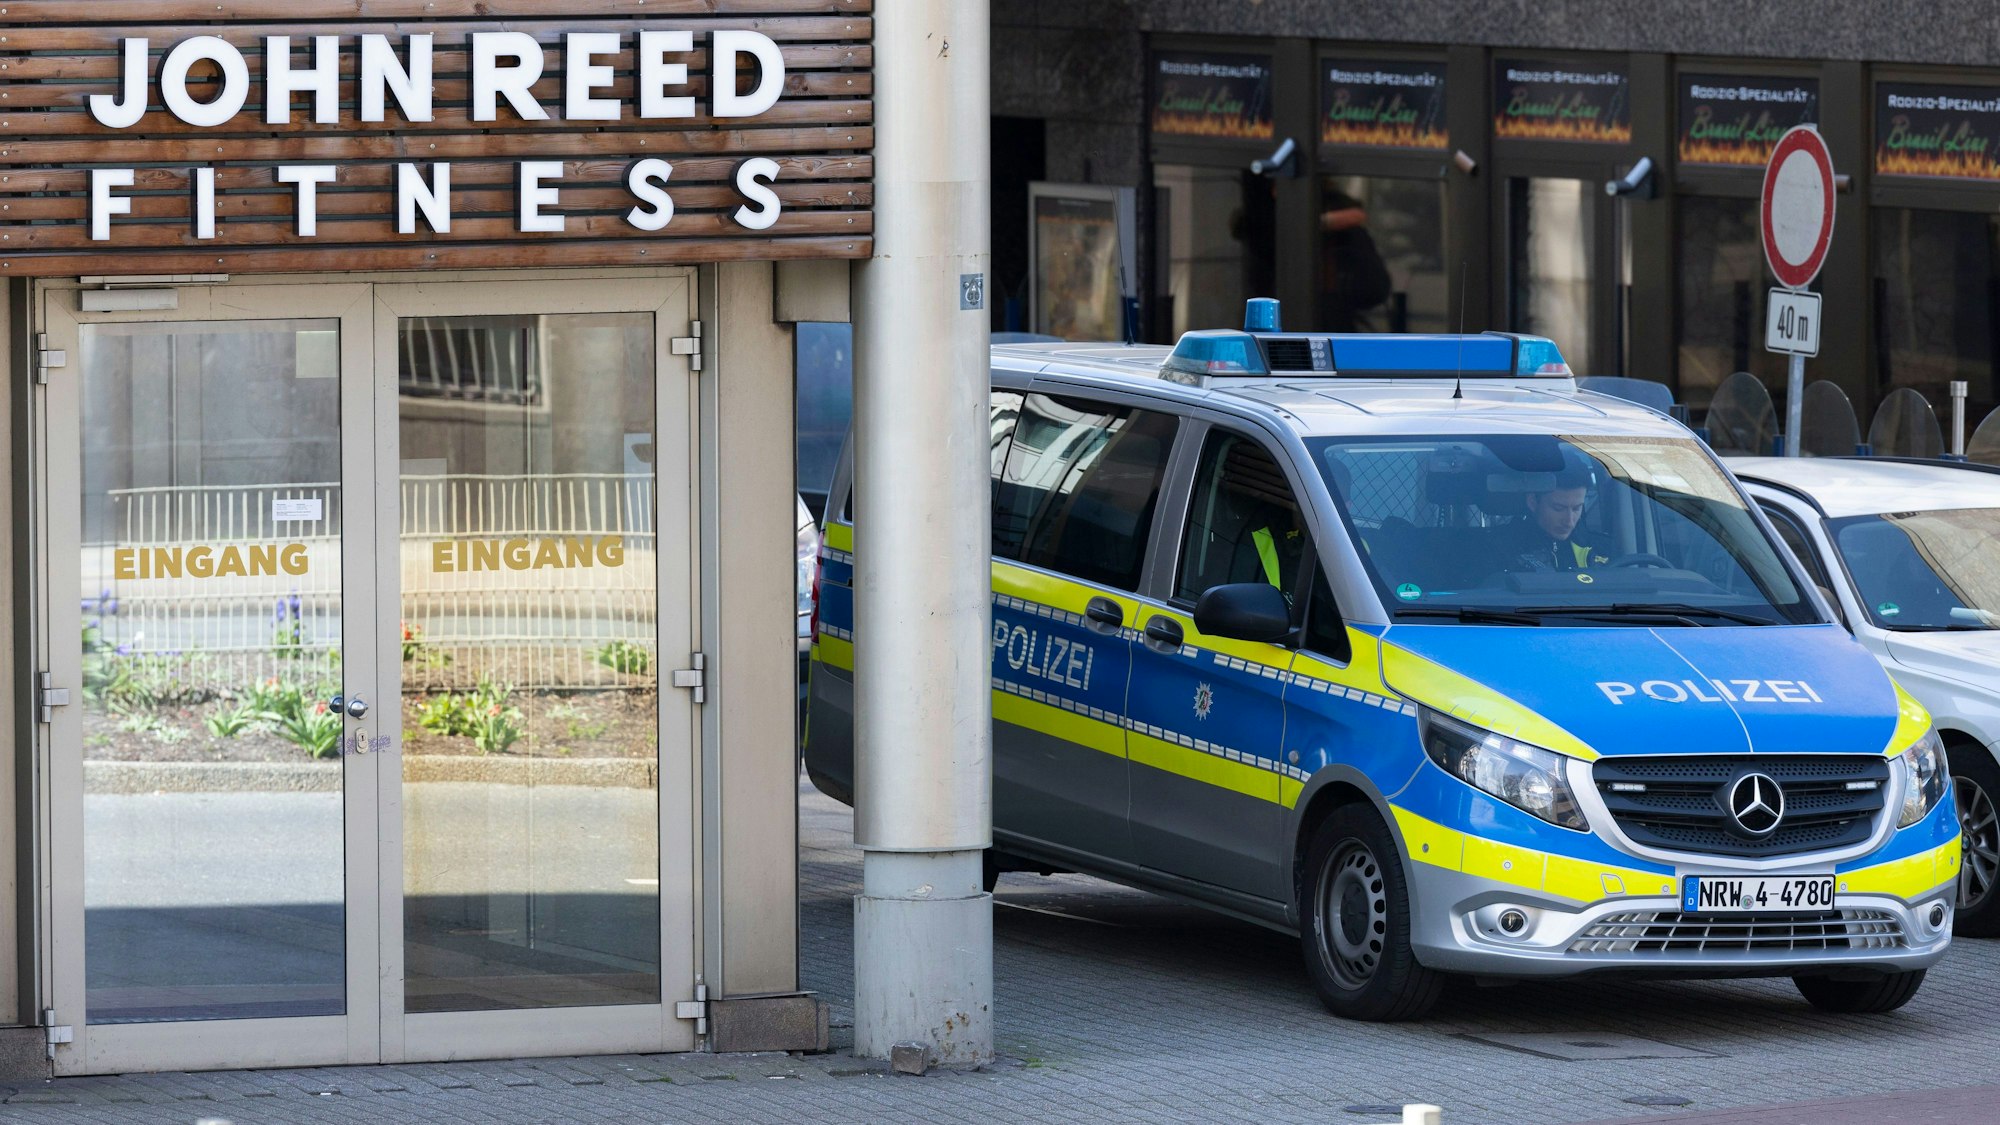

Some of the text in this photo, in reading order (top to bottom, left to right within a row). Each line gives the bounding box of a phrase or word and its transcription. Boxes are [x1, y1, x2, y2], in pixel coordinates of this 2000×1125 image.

[88, 30, 787, 129] JOHN REED
[89, 157, 783, 242] FITNESS
[1777, 304, 1808, 341] 40 m
[114, 544, 309, 580] EINGANG
[432, 534, 625, 574] EINGANG
[991, 619, 1094, 691] POLIZEI
[1595, 679, 1824, 705] POLIZEI
[1687, 897, 1695, 906] D
[1699, 880, 1832, 907] NRW 4-4780
